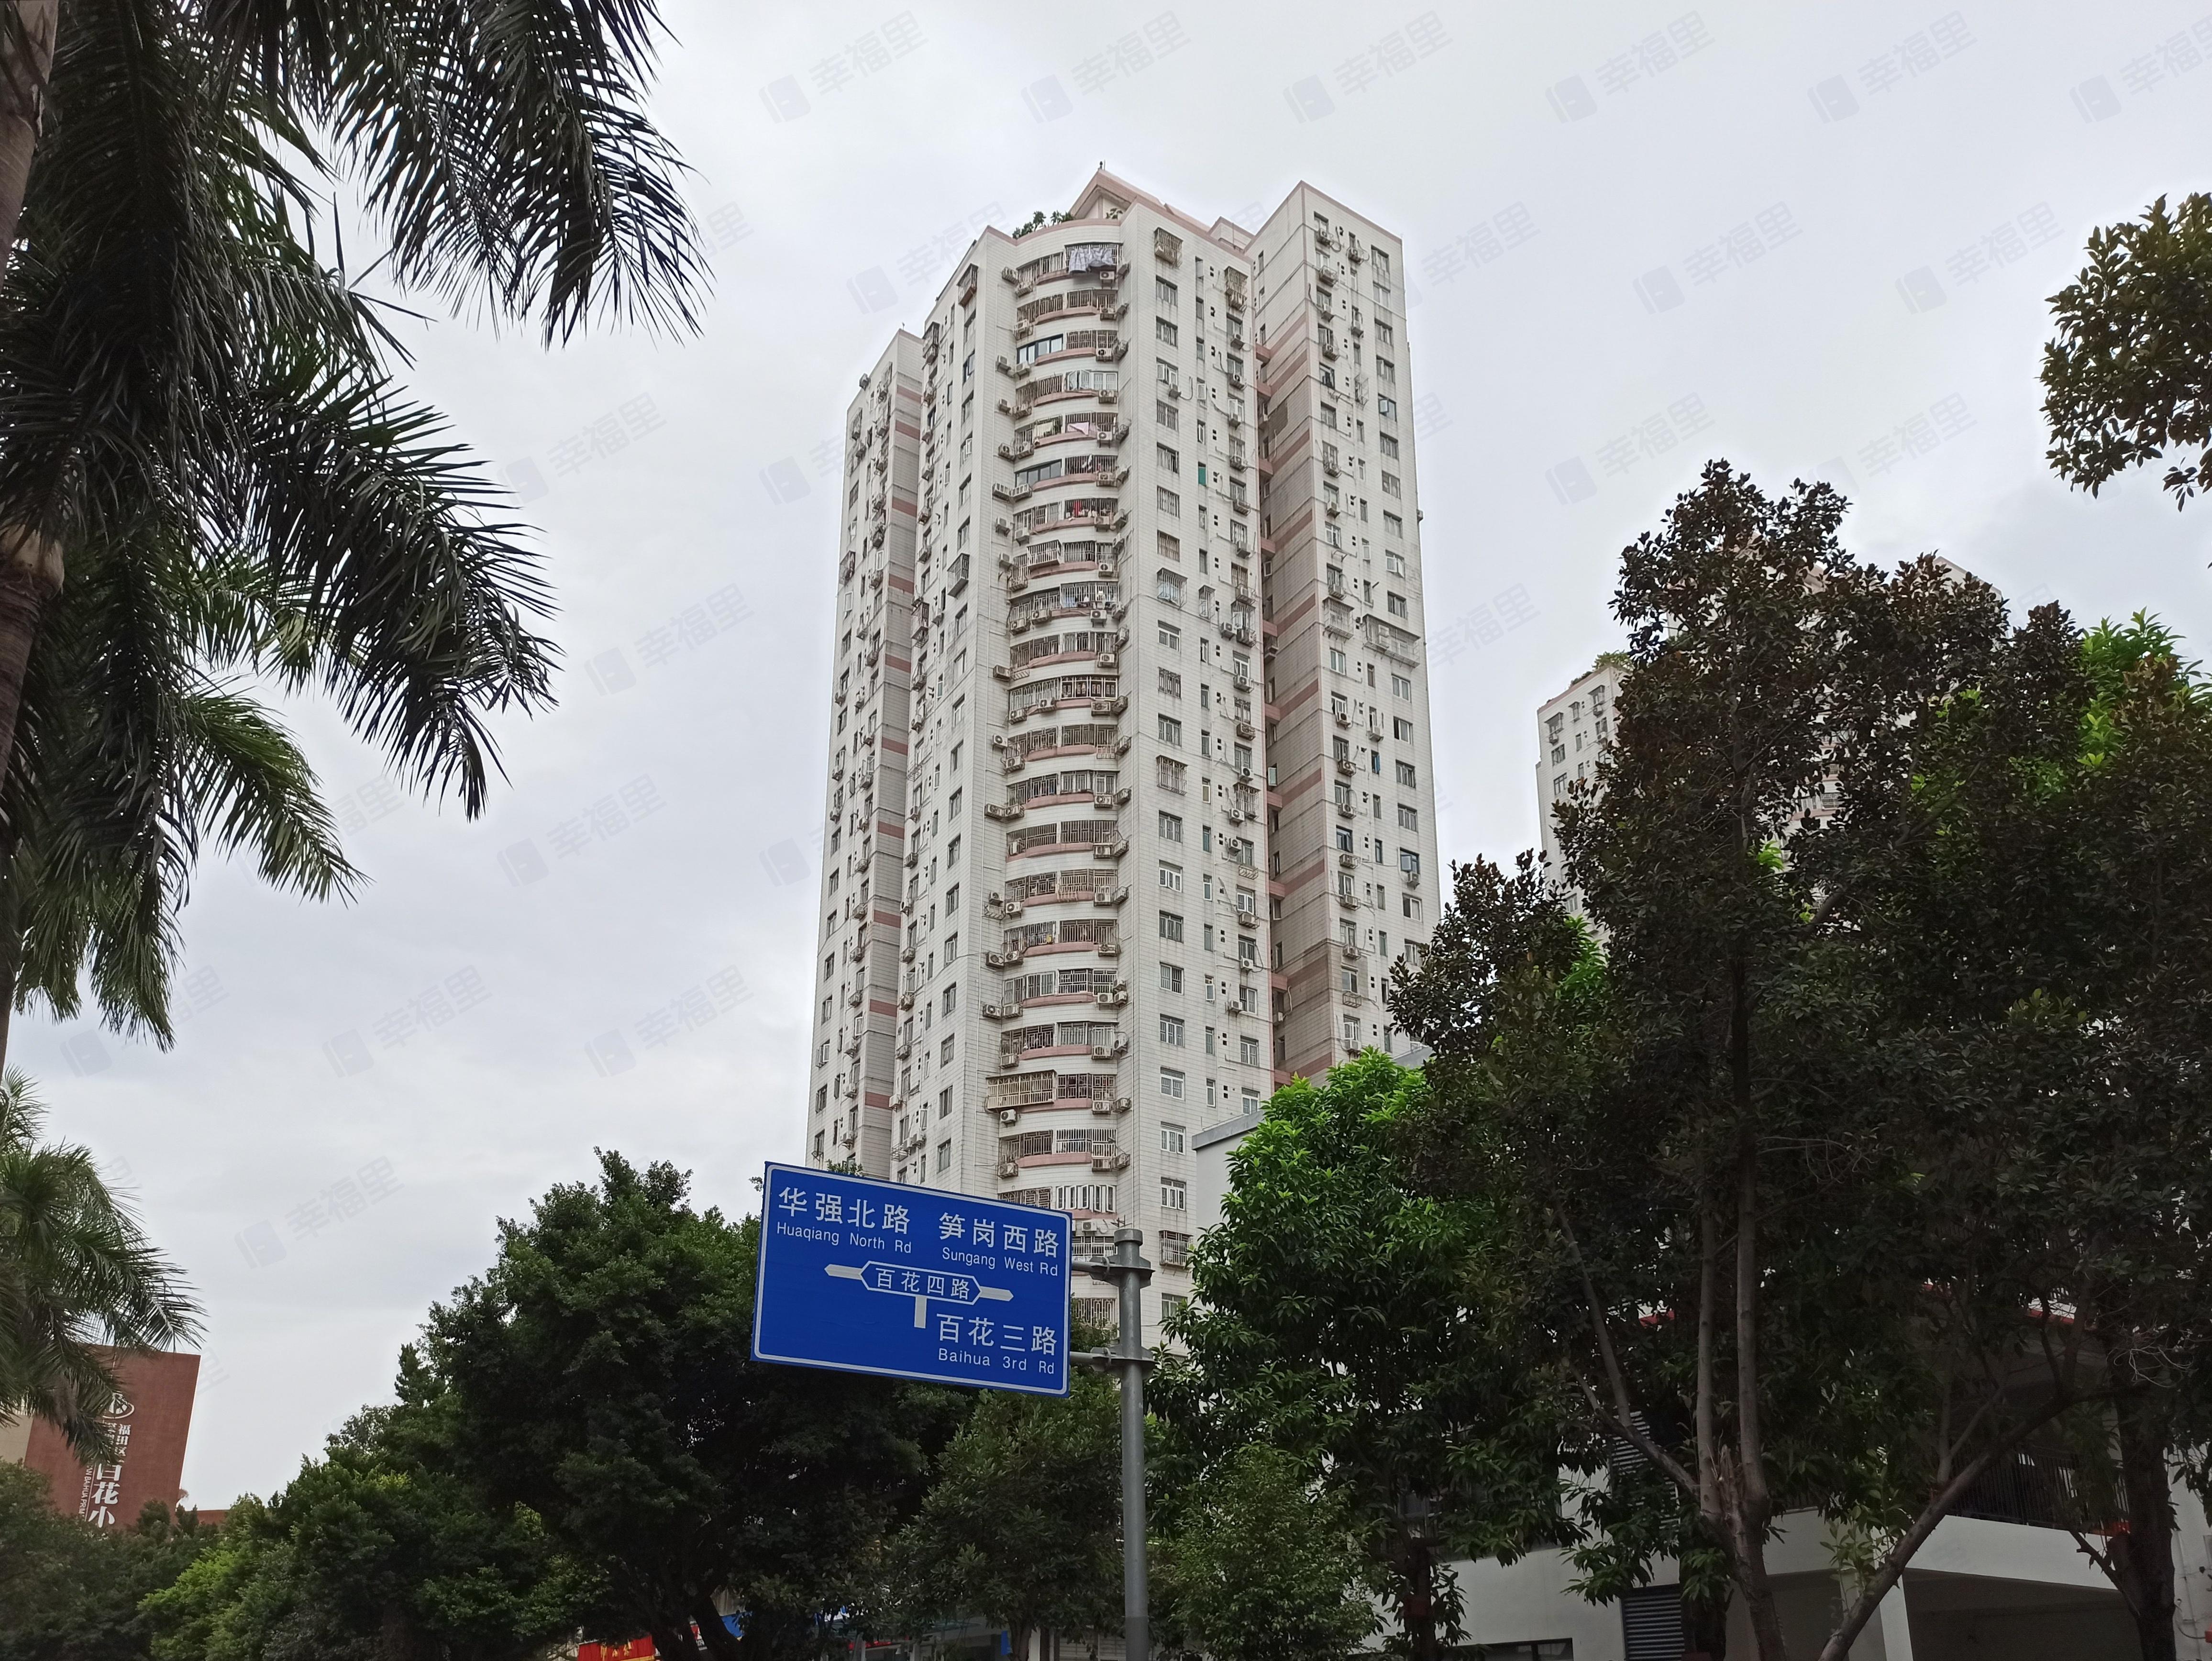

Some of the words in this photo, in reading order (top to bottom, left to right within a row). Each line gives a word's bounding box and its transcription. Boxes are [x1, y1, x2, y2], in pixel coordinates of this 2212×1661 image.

[778, 1186, 911, 1234] 华强北路
[776, 1221, 840, 1246] Huaqiang
[850, 1232, 885, 1250] North
[895, 1240, 912, 1254] Rd
[939, 1212, 1060, 1258] 笋岗西路
[942, 1247, 995, 1270] Sungang
[1004, 1256, 1034, 1273] West
[1040, 1262, 1058, 1276] Rd
[875, 1268, 970, 1300] 百花四路
[936, 1313, 1057, 1356] 百花三路
[938, 1348, 991, 1367] Baihua
[1002, 1356, 1027, 1371] 3rd
[1039, 1361, 1054, 1374] Rd
